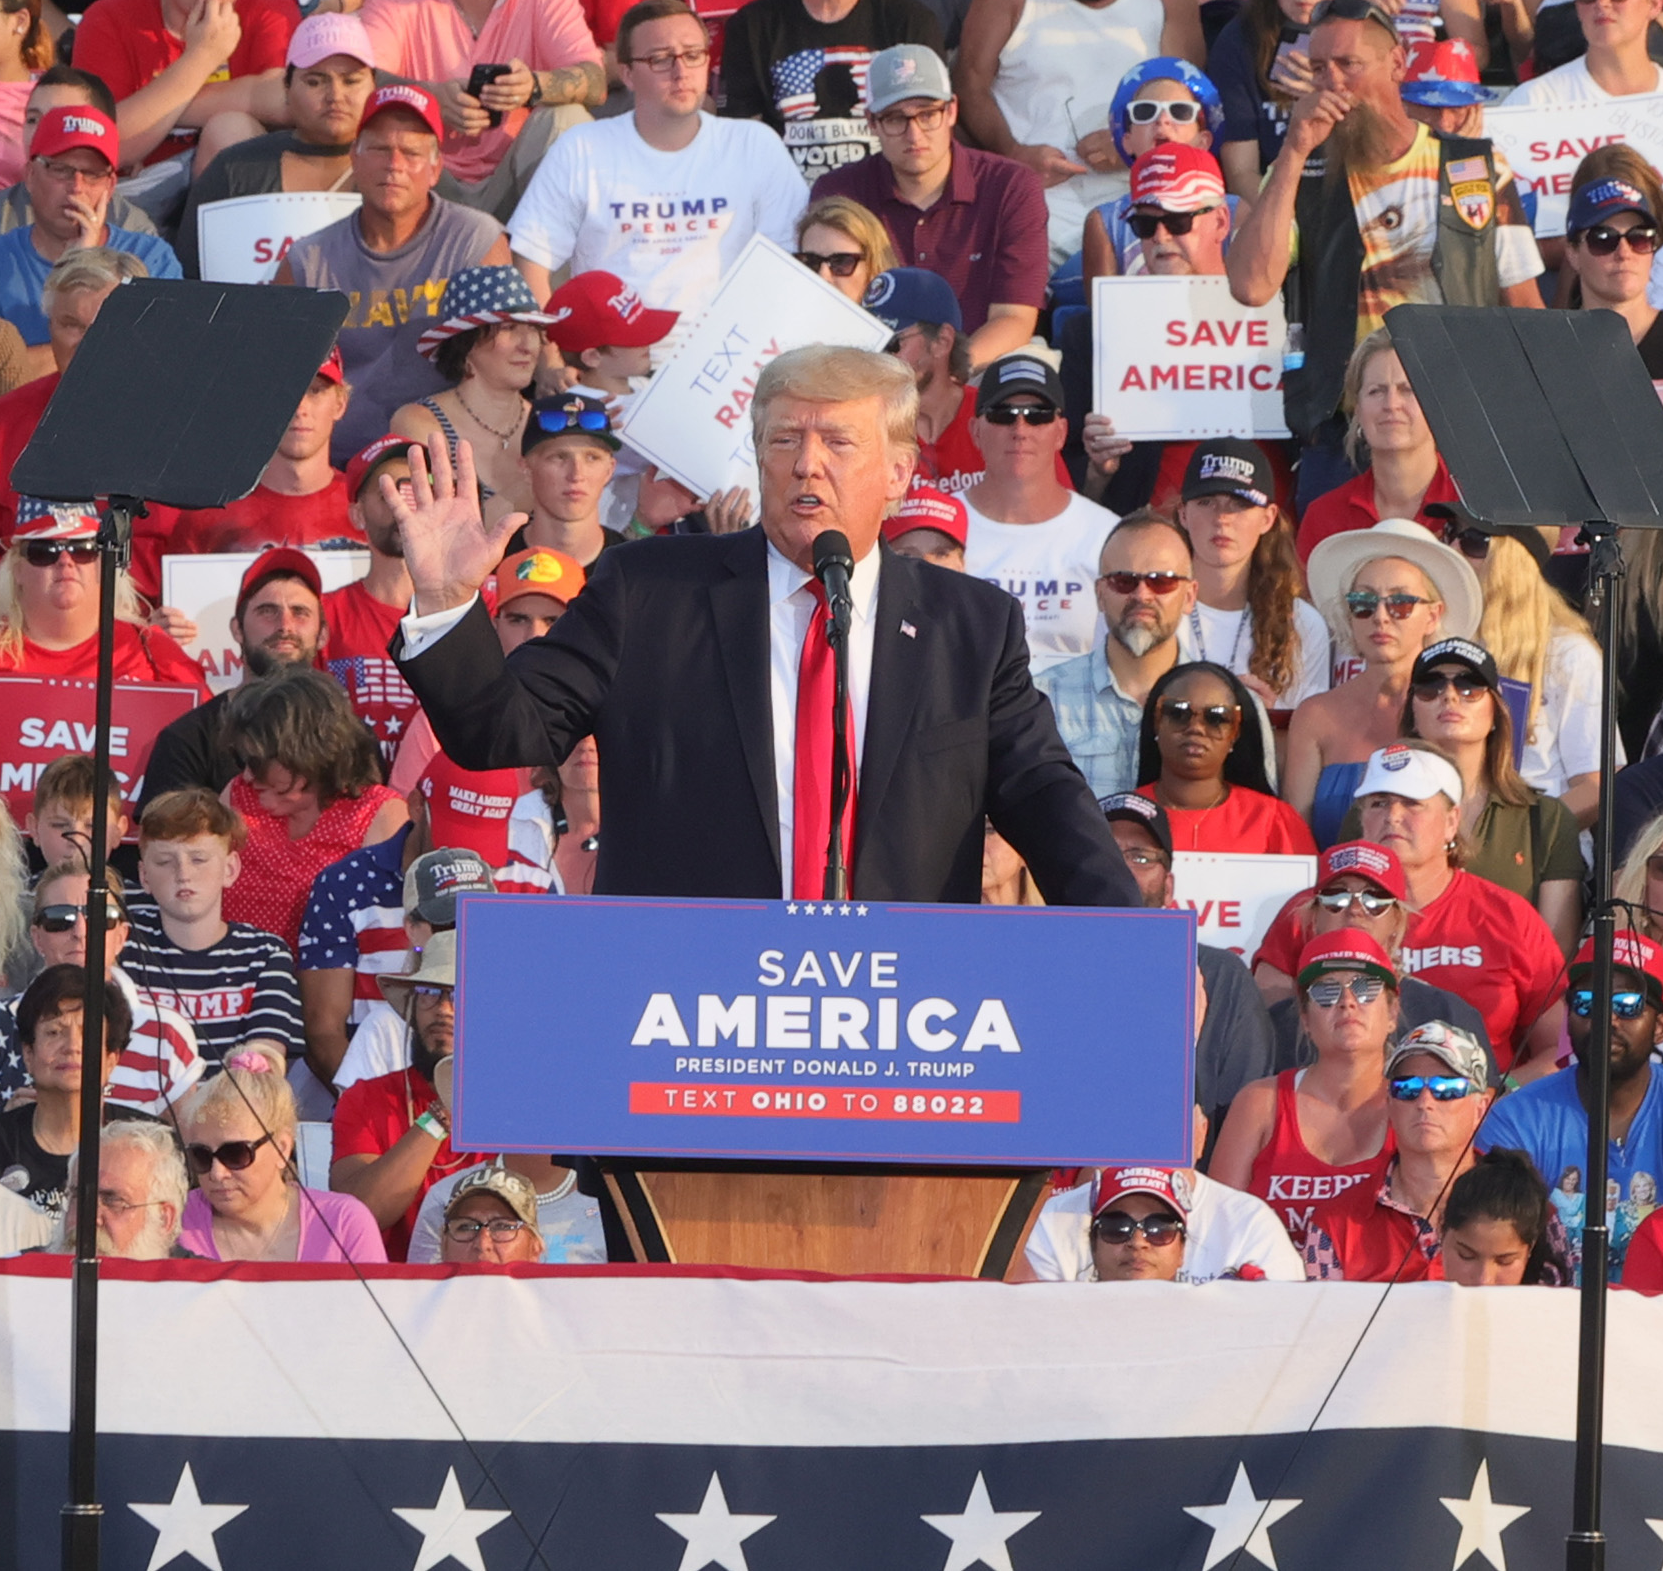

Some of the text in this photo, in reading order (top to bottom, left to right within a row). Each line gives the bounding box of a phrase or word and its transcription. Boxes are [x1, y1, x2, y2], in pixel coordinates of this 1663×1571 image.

[375, 86, 429, 105] Trump
[63, 115, 105, 136] Trump
[788, 124, 830, 141] DON'T
[793, 143, 866, 168] VOTED
[1530, 134, 1627, 163] SAVE
[609, 197, 728, 220] TRUMP
[620, 218, 718, 234] PENCE
[1165, 319, 1269, 348] SAVE
[689, 323, 750, 396] TEXT
[1202, 453, 1255, 477] Trump
[18, 718, 139, 757] SAVE
[449, 785, 478, 803] MAKE
[450, 798, 483, 817] GREAT
[428, 858, 484, 882] Trump
[757, 950, 899, 989] SAVE
[630, 993, 1023, 1054] AMERICA
[675, 1057, 976, 1079] PRESIDENT DONALD J. TRUMP
[665, 1089, 985, 1116] TEXT OHIO TO 88022
[459, 1167, 522, 1193] FU46
[1114, 1167, 1172, 1185] AMERICA
[1120, 1177, 1167, 1191] GREAT!
